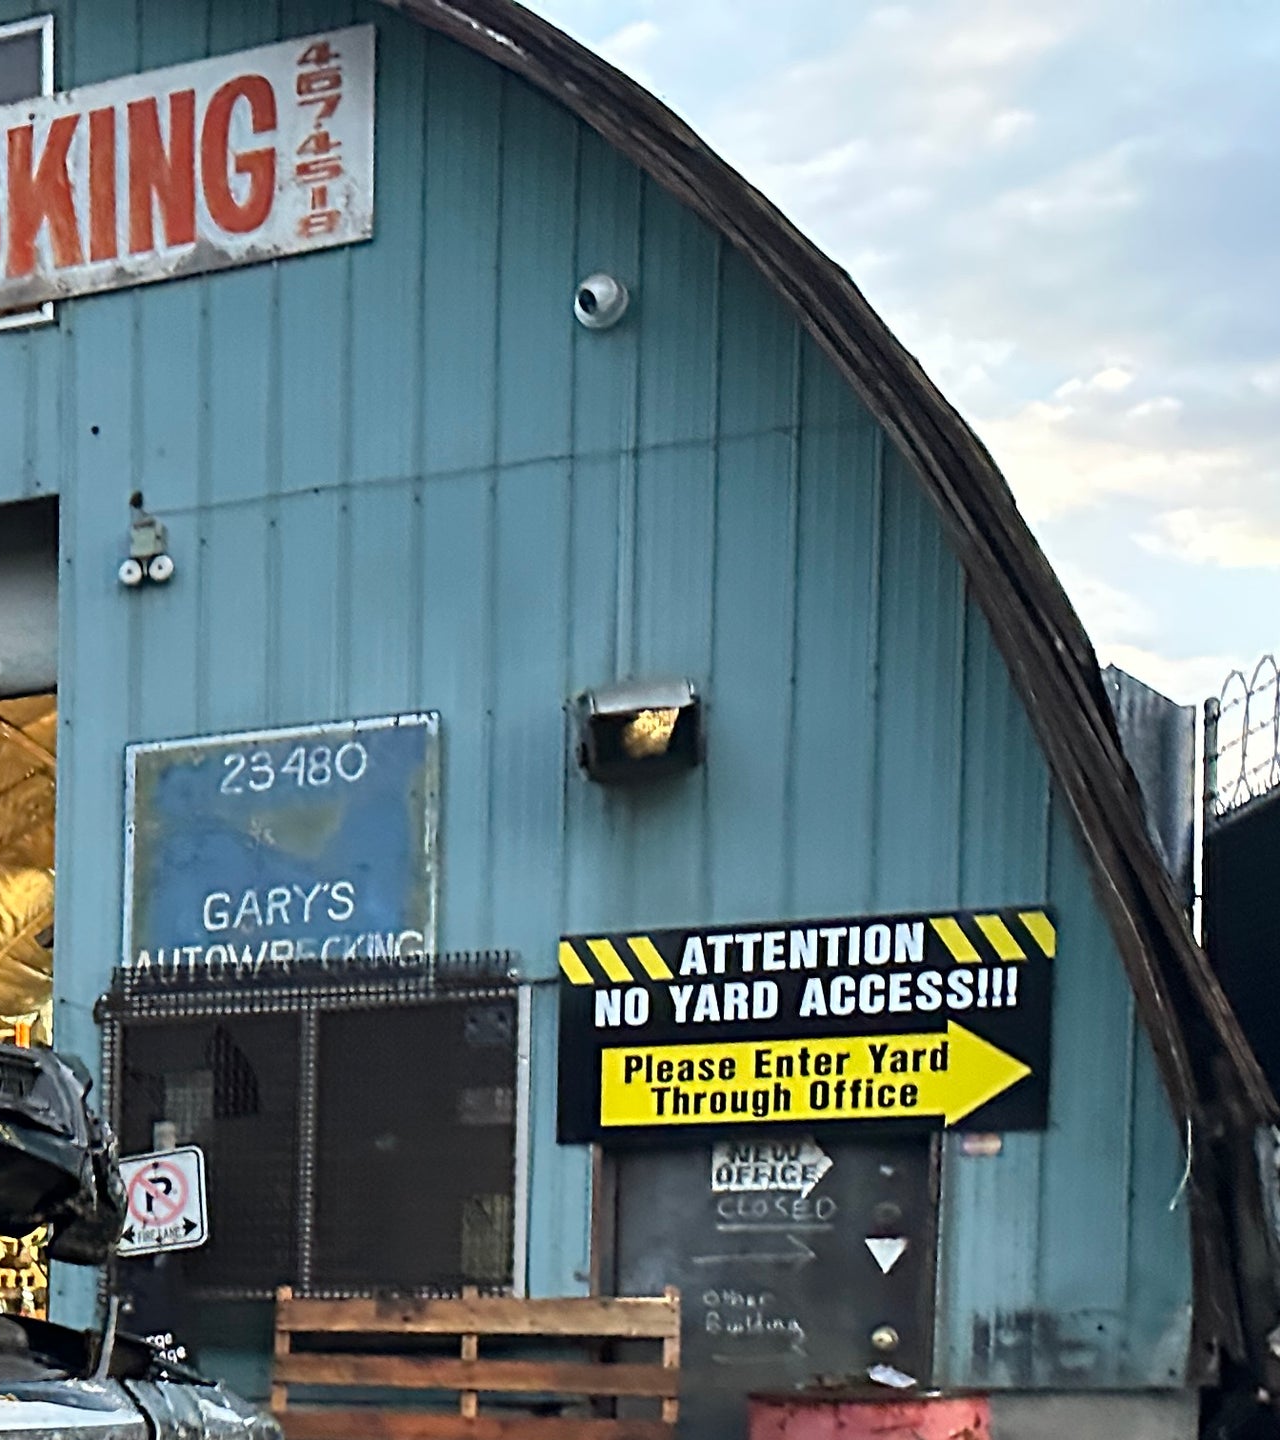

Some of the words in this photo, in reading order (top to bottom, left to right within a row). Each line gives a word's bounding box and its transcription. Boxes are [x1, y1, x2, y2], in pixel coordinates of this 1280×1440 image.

[220, 742, 368, 794] 23480
[203, 881, 354, 932] GARY'S
[679, 922, 924, 976] ATTENTION
[594, 986, 649, 1027] NO
[669, 980, 778, 1024] YARD
[799, 967, 1018, 1018] ACCESS!!!
[624, 1052, 736, 1084] Please
[754, 1047, 851, 1079] Enter
[868, 1041, 949, 1074] Yard
[651, 1084, 791, 1118] Through
[809, 1080, 919, 1110] Office
[717, 1196, 837, 1221] CLOSED
